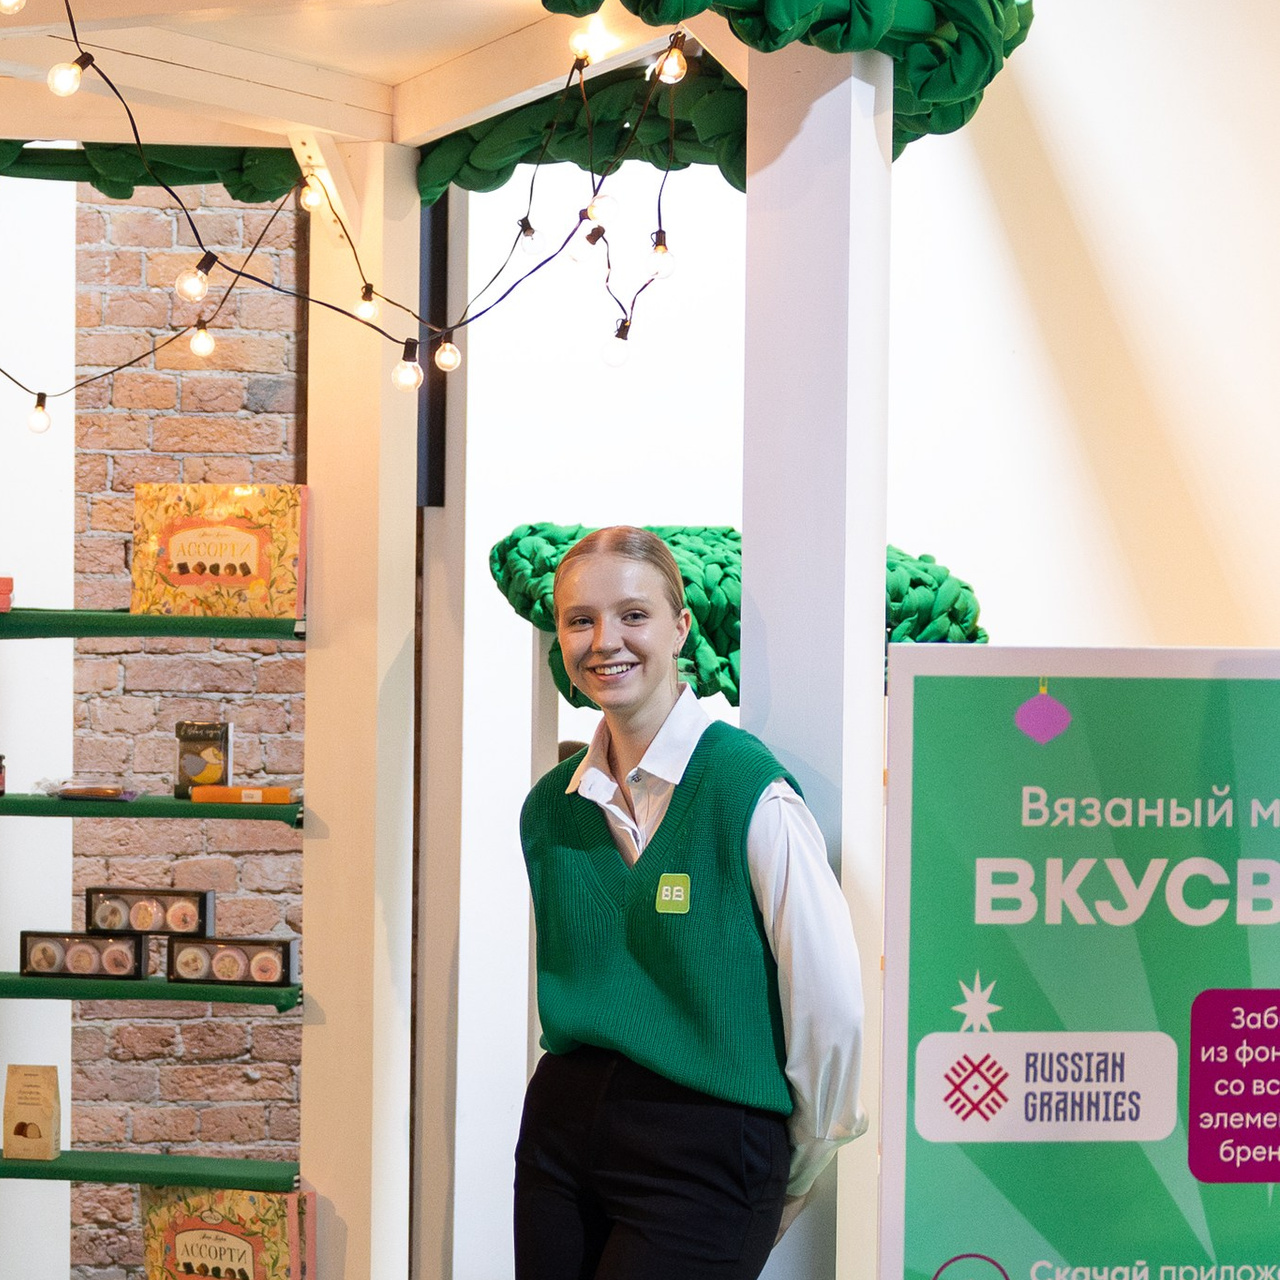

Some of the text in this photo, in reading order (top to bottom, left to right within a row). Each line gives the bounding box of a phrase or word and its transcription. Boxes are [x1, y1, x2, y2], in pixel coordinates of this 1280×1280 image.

[1021, 785, 1234, 828] Вязаный
[1231, 1006, 1280, 1030] Заб
[1201, 1046, 1228, 1063] из
[1024, 1051, 1126, 1084] RUSSIAN
[1214, 1079, 1245, 1096] со
[1023, 1091, 1141, 1124] GRANNIES
[1199, 1112, 1280, 1129] элеме
[181, 1243, 247, 1264] АССОРТИ
